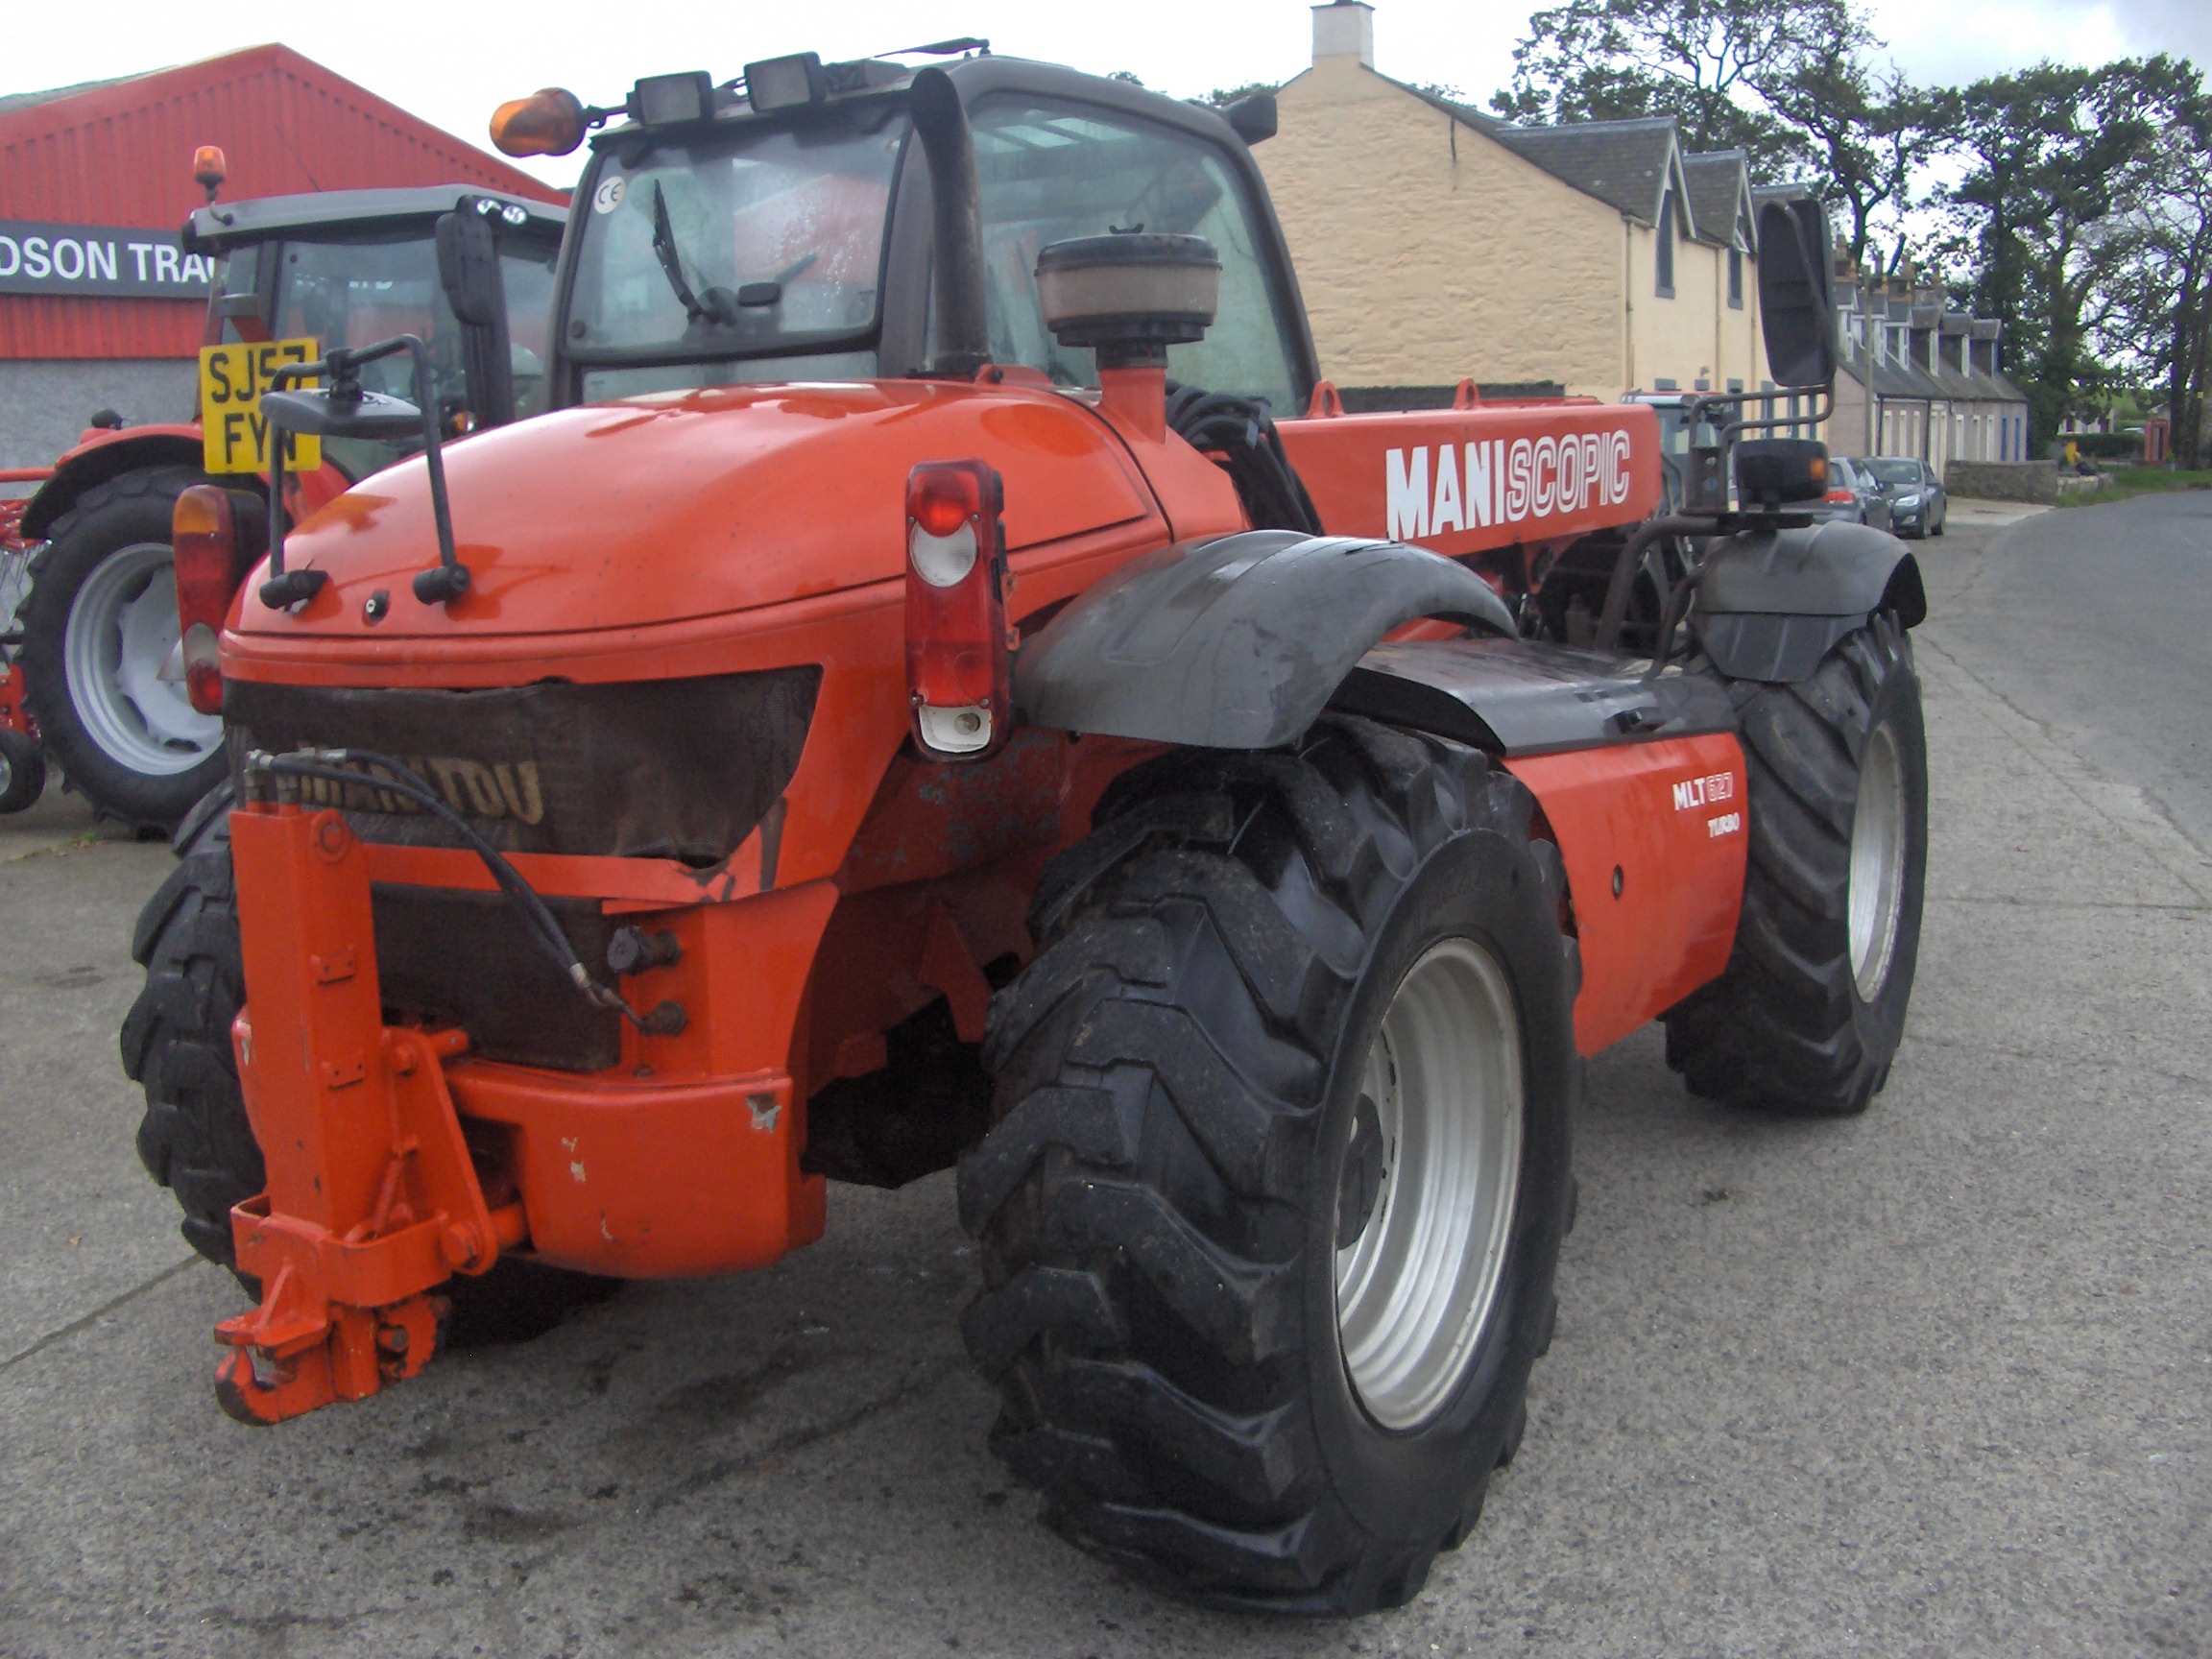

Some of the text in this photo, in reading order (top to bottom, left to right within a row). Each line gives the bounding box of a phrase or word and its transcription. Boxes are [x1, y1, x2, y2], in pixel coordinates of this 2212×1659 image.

[0, 235, 117, 280] DSON
[209, 345, 305, 404] SJ57
[1385, 429, 1630, 541] MANISCOPIC
[1672, 778, 1705, 811] MLT
